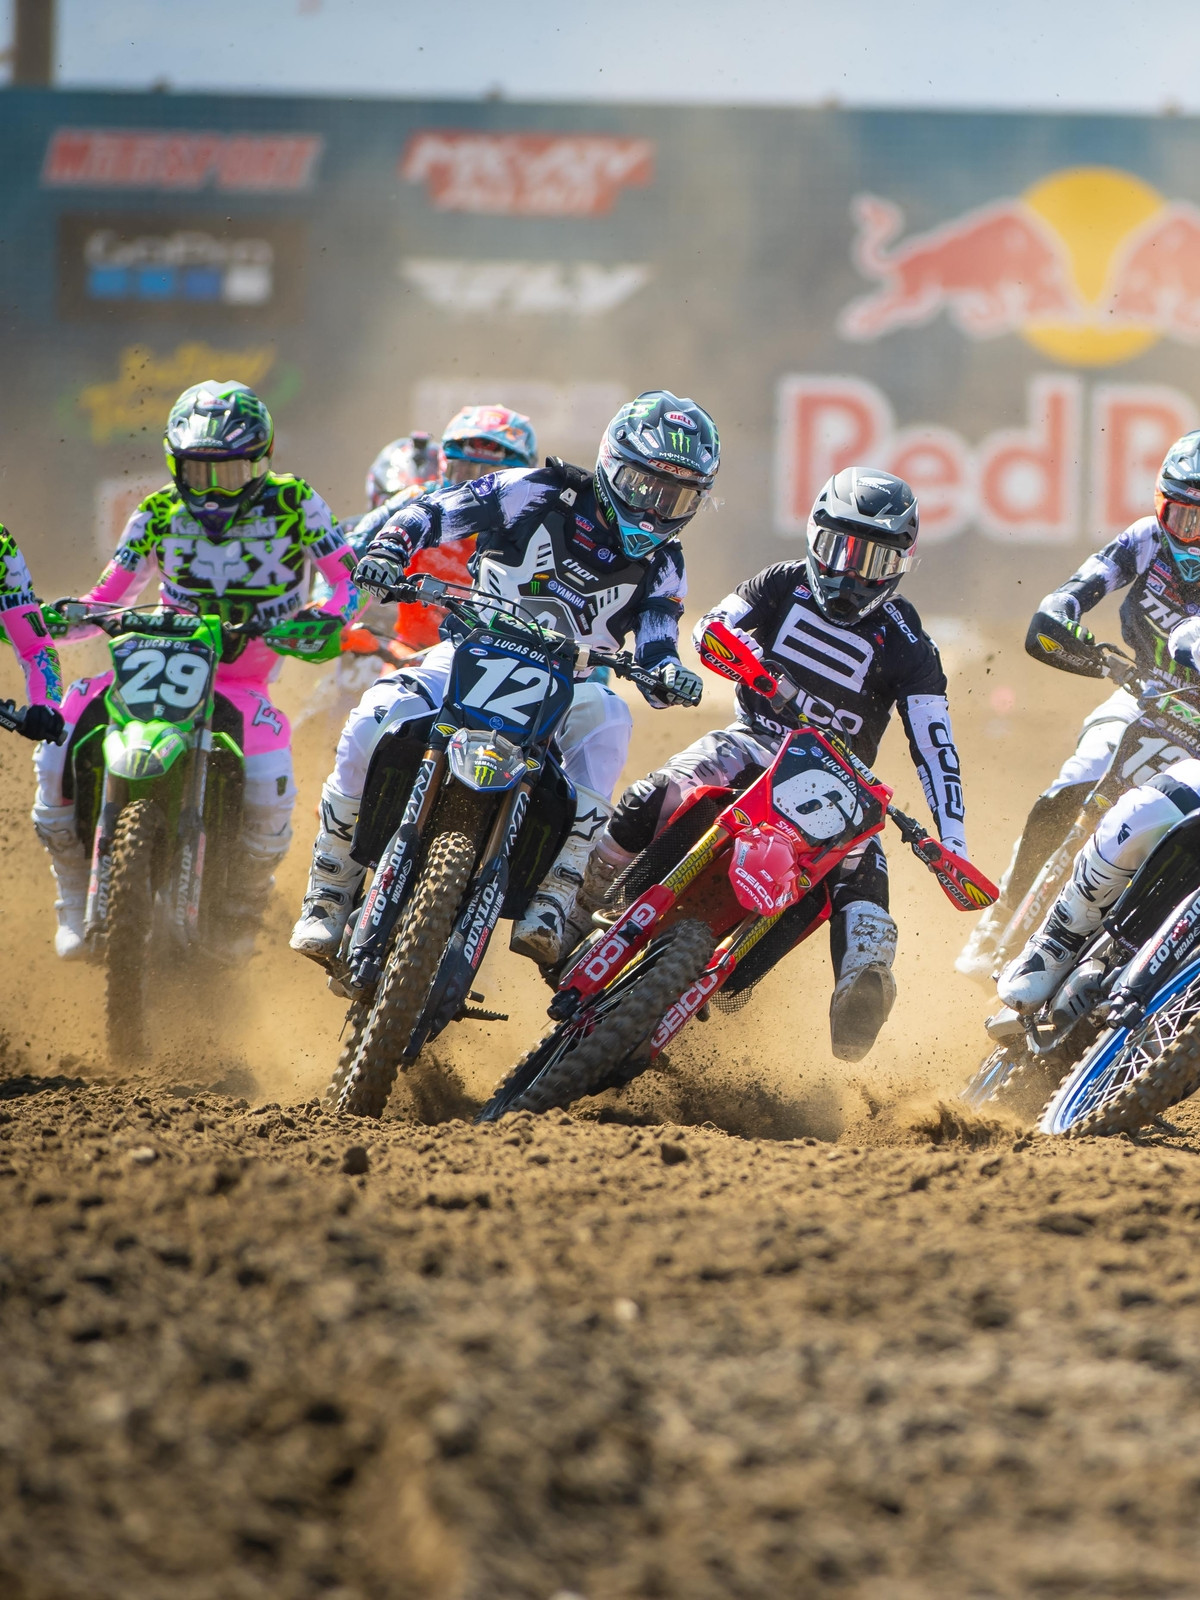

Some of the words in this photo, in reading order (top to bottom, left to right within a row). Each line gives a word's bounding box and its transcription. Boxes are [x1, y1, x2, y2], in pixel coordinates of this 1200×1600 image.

[669, 413, 694, 428] BELL
[648, 458, 681, 476] FLEX
[658, 451, 702, 469] MONSTER
[780, 377, 1080, 541] Red
[858, 481, 892, 495] HONDA
[171, 517, 275, 538] Kasaki
[562, 558, 600, 582] thor
[556, 584, 586, 609] YAMAHA
[882, 600, 919, 644] GEICO
[138, 639, 172, 649] LUCAS
[173, 641, 191, 652] OIL
[494, 638, 530, 655] LUCAS
[529, 648, 547, 664] OIL
[119, 648, 210, 709] 29
[704, 651, 742, 682] CYCRA
[461, 656, 559, 726] 12
[795, 689, 864, 736] ICO
[1166, 724, 1198, 748] LUCAS
[821, 755, 850, 783] LUCAS
[1121, 736, 1194, 786] 13
[772, 769, 864, 840] 6
[776, 820, 802, 843] SHIFT
[371, 836, 407, 928] DULOP
[392, 874, 407, 904] CYCRA
[735, 866, 775, 909] GEICO
[736, 878, 764, 910] HONDA
[936, 872, 970, 907] CYCRA
[1023, 849, 1071, 931] DULOP
[467, 884, 482, 916] CYC
[487, 891, 505, 931] YAMALUBE
[1174, 931, 1196, 961] CYCRA
[651, 973, 718, 1049] GEICO
